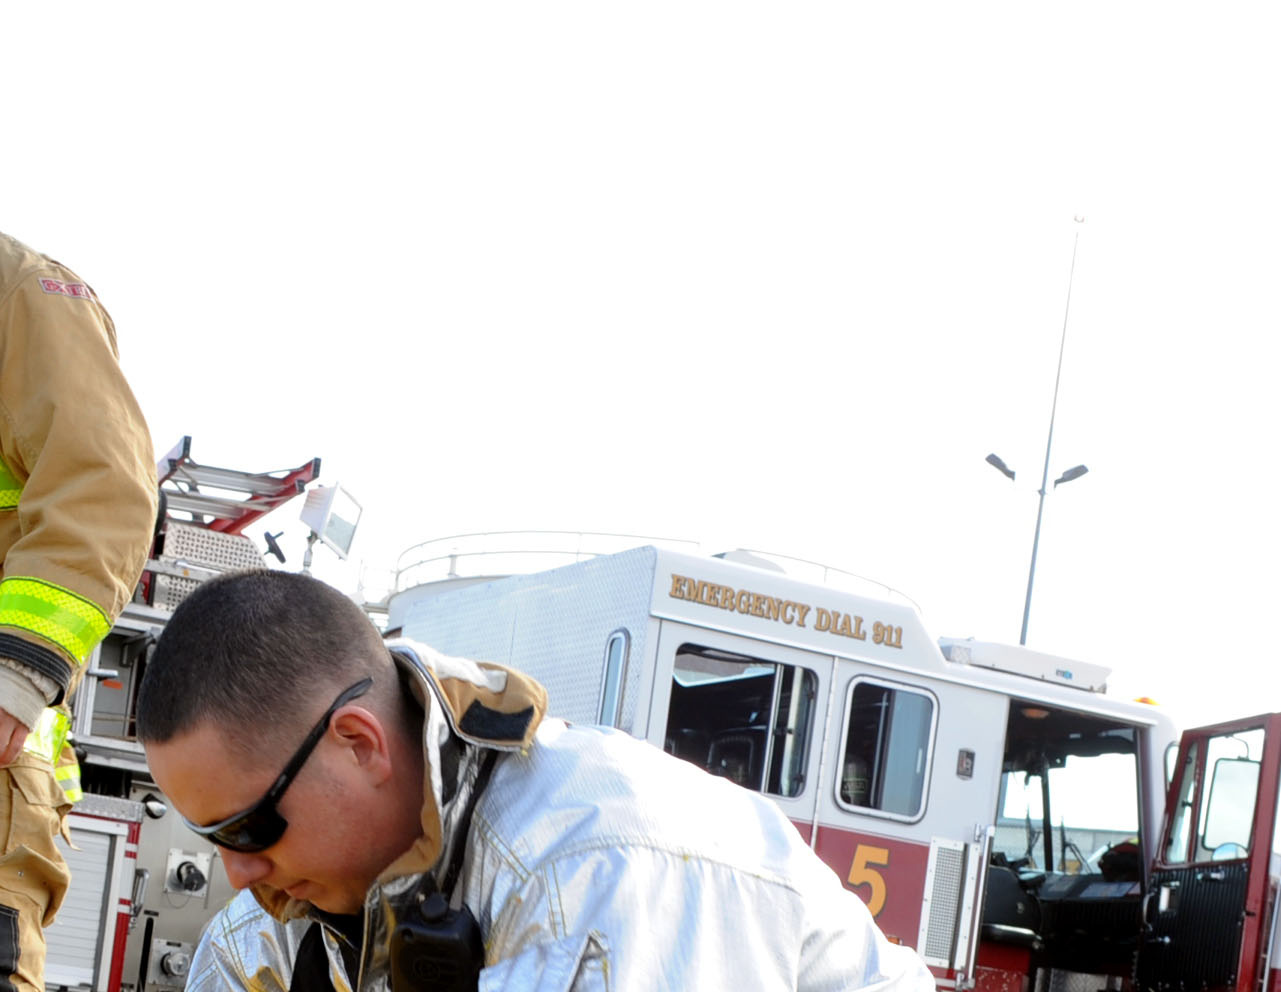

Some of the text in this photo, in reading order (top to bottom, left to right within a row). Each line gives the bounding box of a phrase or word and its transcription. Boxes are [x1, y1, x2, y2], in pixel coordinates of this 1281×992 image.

[670, 574, 903, 648] EMERGENCY DIAL 911
[847, 844, 889, 919] 5
